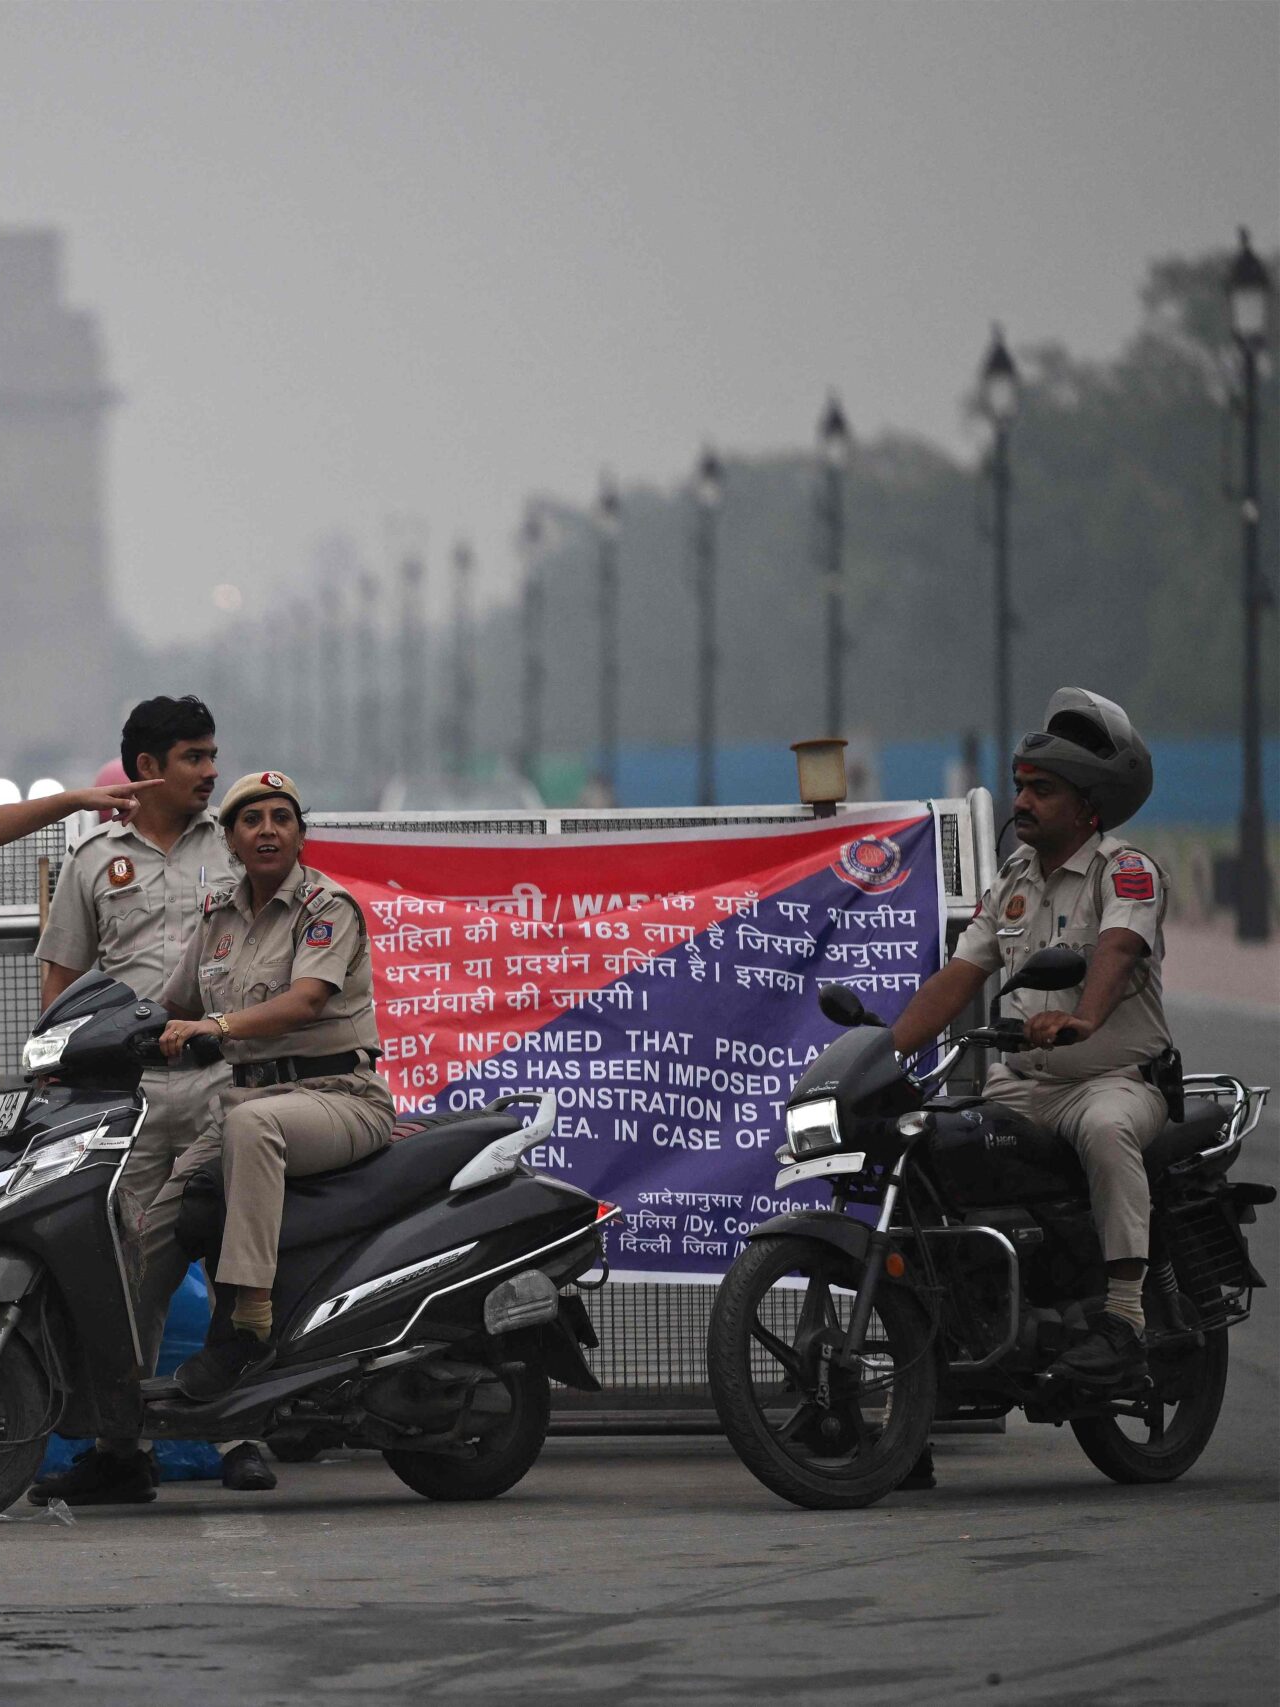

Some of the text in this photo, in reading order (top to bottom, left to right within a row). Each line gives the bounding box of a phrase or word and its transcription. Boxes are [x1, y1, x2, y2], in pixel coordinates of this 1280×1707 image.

[713, 891, 759, 918] यहाँ
[777, 900, 810, 923] पर
[828, 904, 916, 929] भारतीय
[463, 916, 498, 943] की
[579, 921, 629, 940] 163
[641, 923, 700, 952] लागू
[708, 920, 724, 949] है
[736, 924, 816, 958] जिसके
[825, 940, 918, 968] अनुसार
[386, 962, 451, 983] धरना
[463, 957, 492, 979] या
[505, 946, 590, 975] प्रदर्शन
[603, 948, 676, 977] वर्जित
[734, 964, 804, 994] इसका
[386, 984, 496, 1017] कार्यवाही
[505, 982, 540, 1010] की
[458, 1029, 602, 1053] INFORMED
[626, 1030, 693, 1056] THAT
[399, 1064, 439, 1089] 163
[447, 1059, 518, 1083] BNSS
[526, 1060, 581, 1080] HAS
[589, 1060, 660, 1083] BEEN
[668, 1062, 781, 1096] IMPOSED
[448, 1088, 487, 1111] OR
[734, 1103, 758, 1123] IS
[614, 1118, 639, 1142] IN
[652, 1123, 721, 1150] CASE
[735, 1129, 770, 1149] OF
[637, 1188, 742, 1212] आदेशानुसार
[625, 1209, 676, 1234] पुलिस
[619, 1232, 671, 1254] दिल्ली
[681, 1235, 727, 1256] जिला
